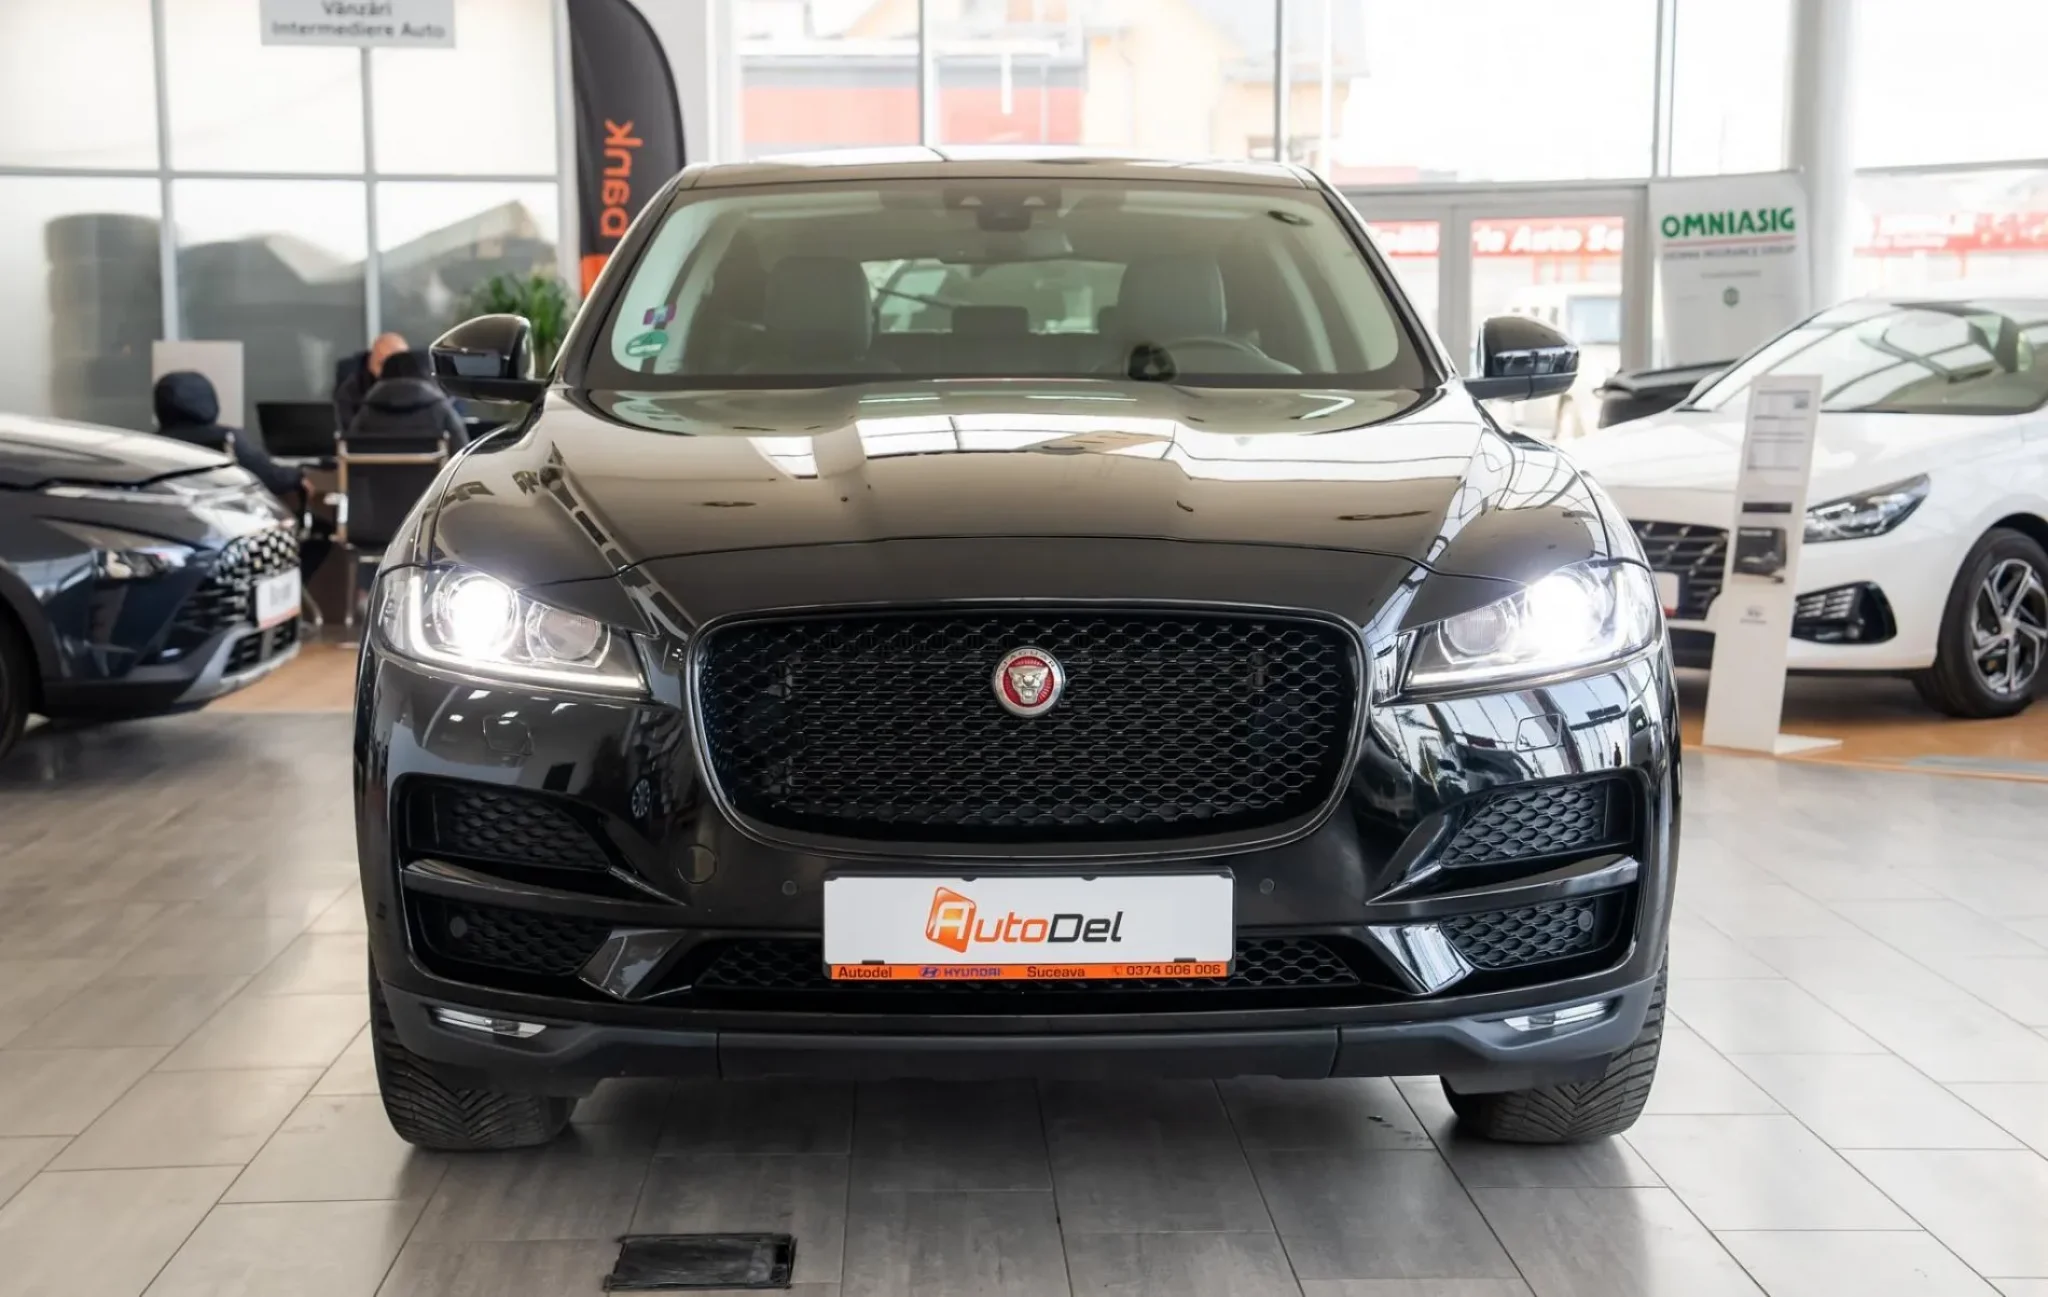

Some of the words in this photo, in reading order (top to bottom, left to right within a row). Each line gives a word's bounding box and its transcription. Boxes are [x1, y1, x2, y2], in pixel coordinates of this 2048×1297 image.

[272, 20, 394, 37] Intermediere
[401, 21, 446, 38] Auto
[1661, 207, 1796, 238] OMNIASIG
[932, 900, 1124, 943] AutoDel
[838, 966, 892, 978] Autodel
[944, 967, 1001, 977] HYUNDAI
[1027, 966, 1085, 978] Suceava
[1126, 965, 1161, 976] 0374
[1165, 965, 1191, 975] 006
[1195, 964, 1221, 975] 006
